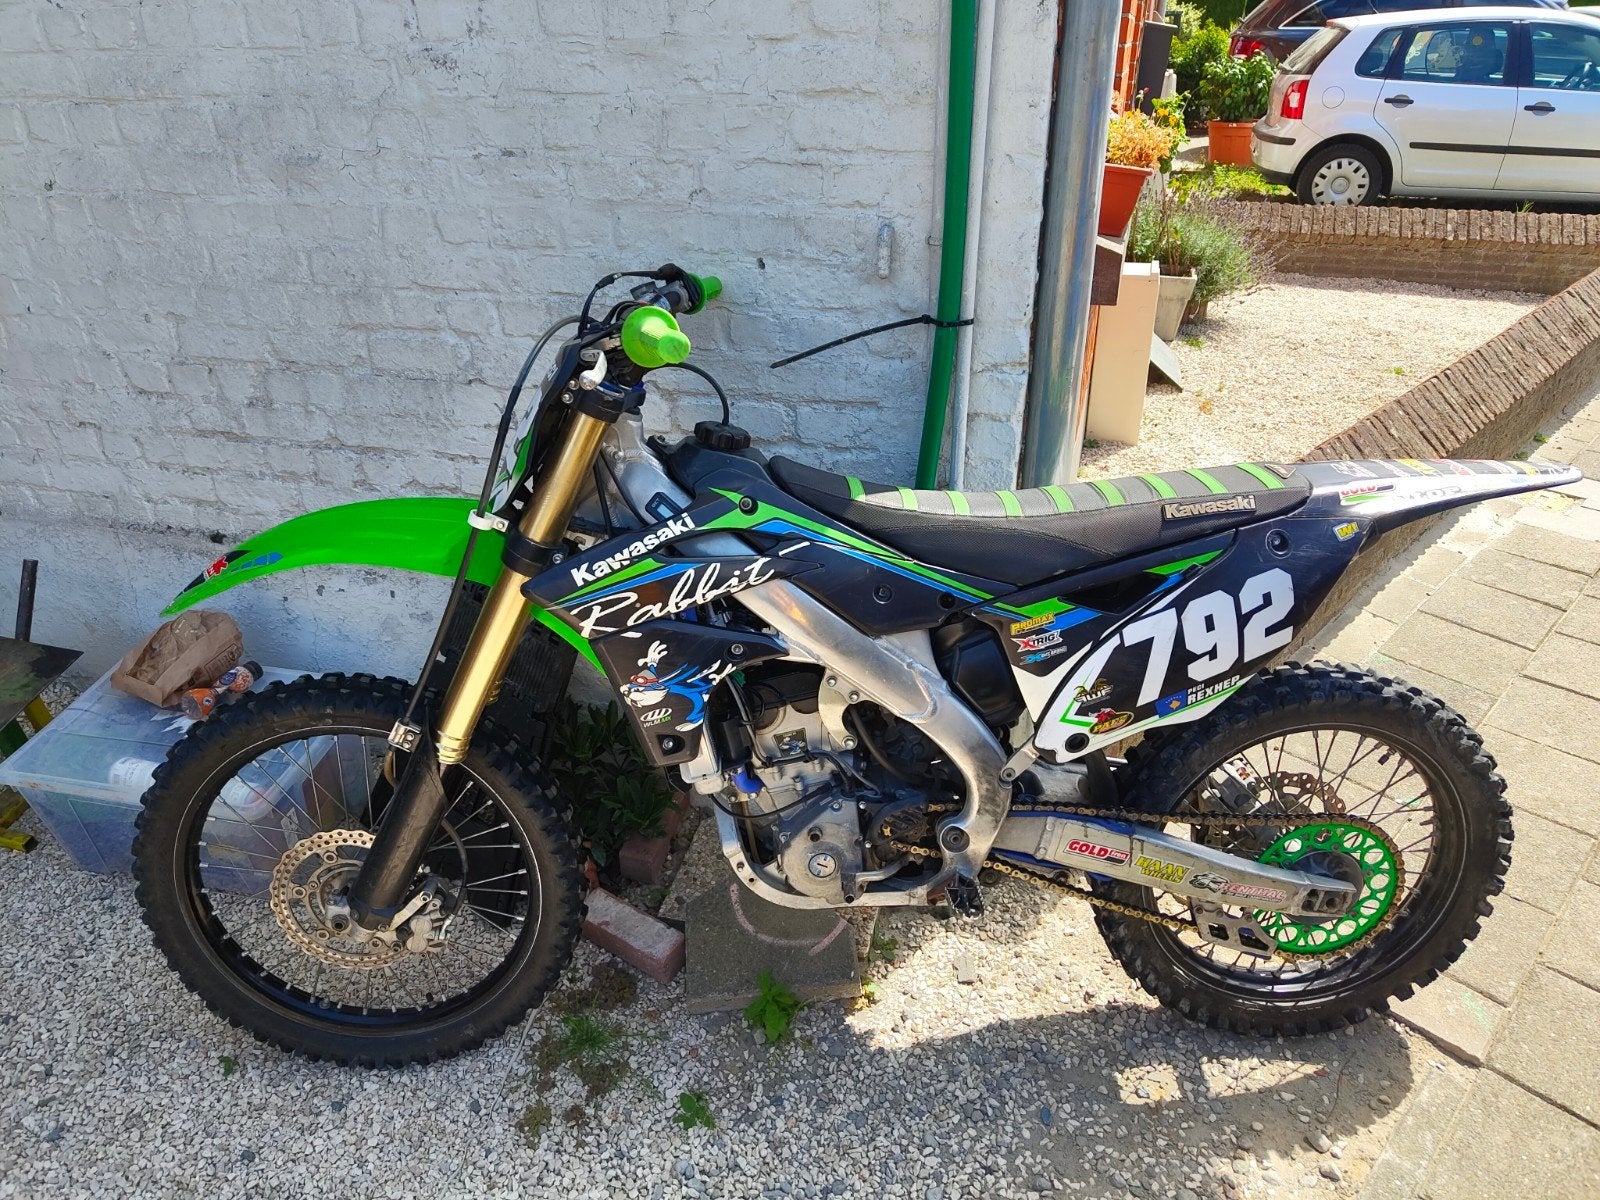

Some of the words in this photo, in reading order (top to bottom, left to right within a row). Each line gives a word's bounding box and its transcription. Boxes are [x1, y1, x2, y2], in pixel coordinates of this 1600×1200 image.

[1164, 495, 1256, 519] Kawasaki
[570, 513, 696, 588] Kawasaki
[570, 542, 810, 638] Rabbit
[1010, 612, 1055, 635] PROMAX
[1020, 633, 1057, 650] XTRIG
[1121, 567, 1295, 708] 792
[1187, 675, 1240, 705] REXHEP
[1068, 840, 1109, 858] GOLD
[1135, 855, 1190, 877] HAAN
[1140, 867, 1183, 883] WHEELS
[1217, 882, 1287, 900] RENTHAL
